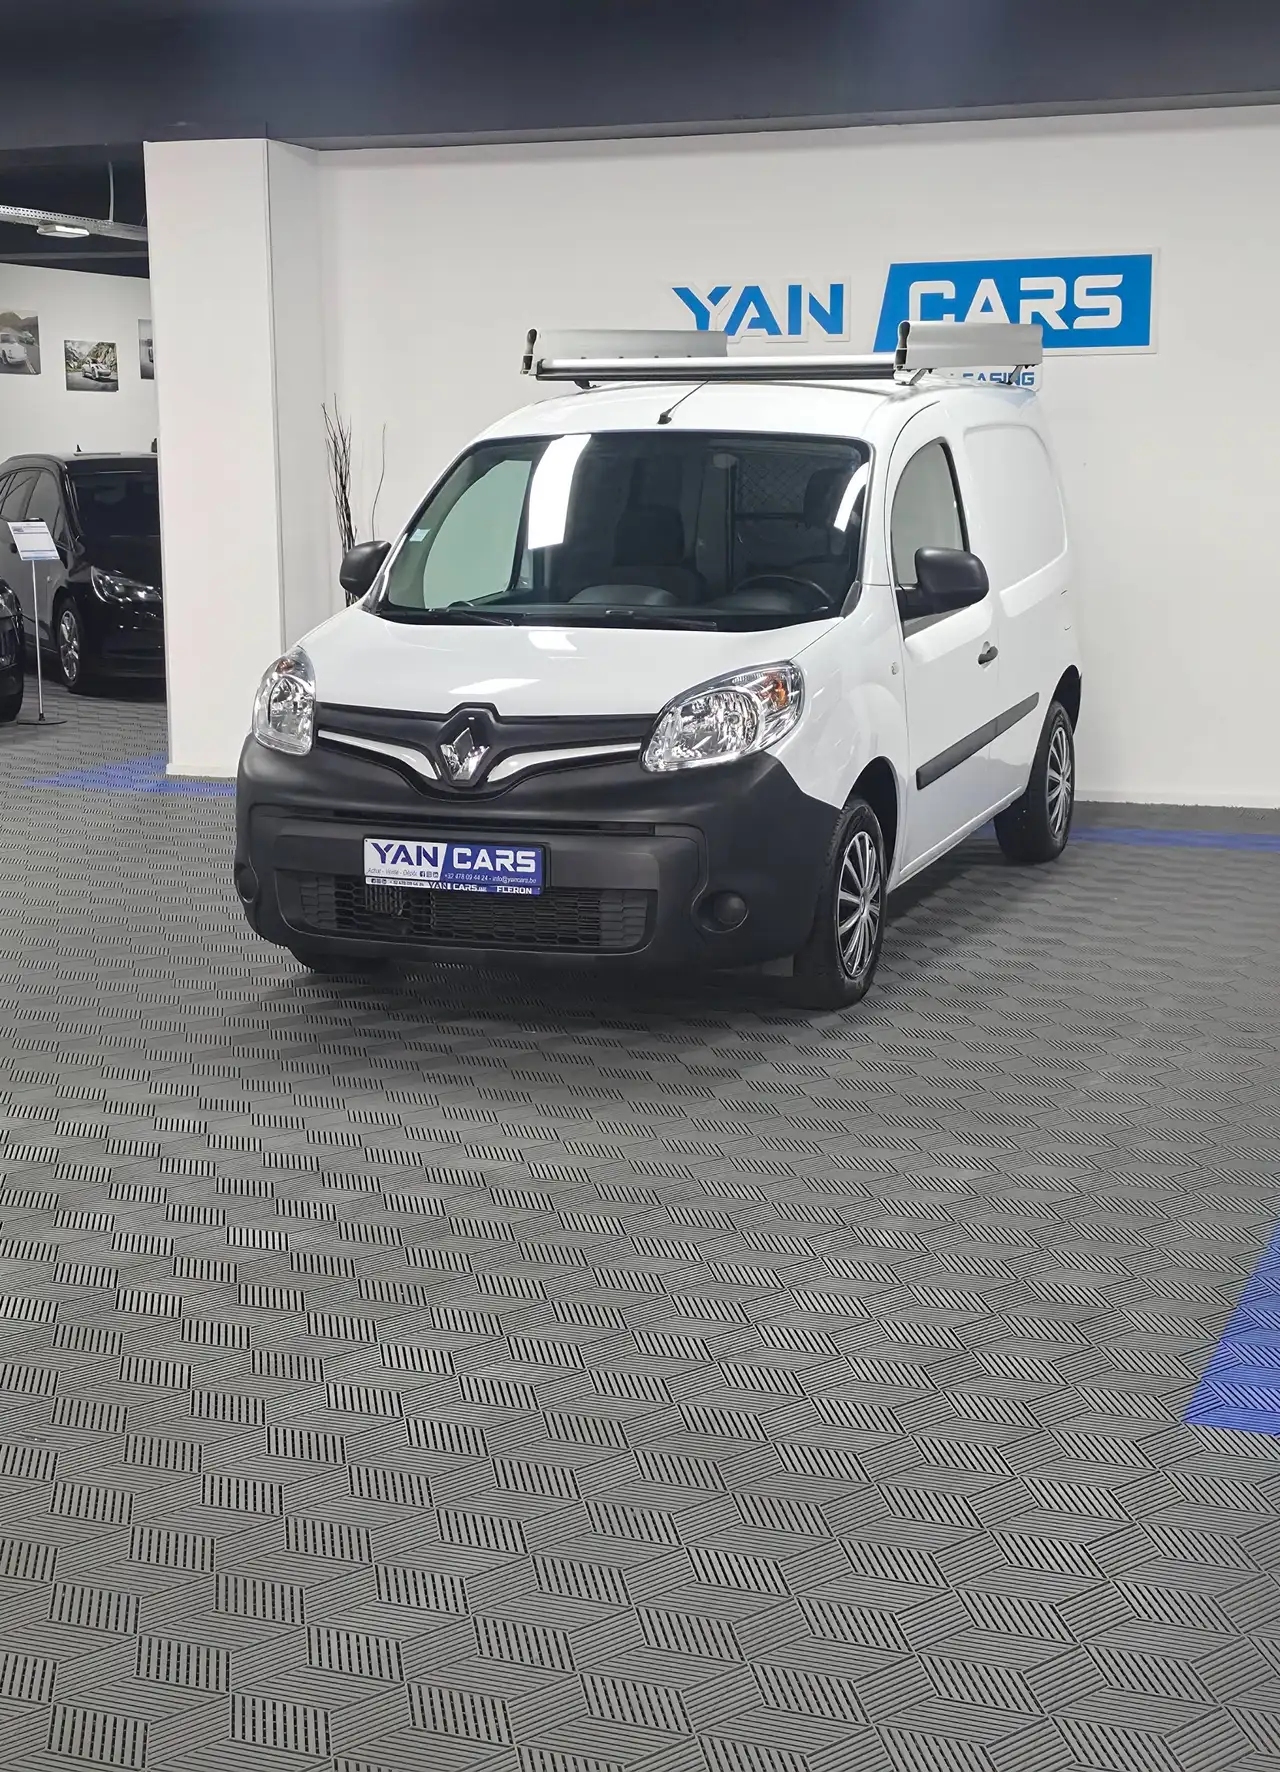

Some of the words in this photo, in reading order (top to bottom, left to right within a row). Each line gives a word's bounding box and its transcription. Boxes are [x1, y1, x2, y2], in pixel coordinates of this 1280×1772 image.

[671, 283, 844, 337] YAN
[908, 273, 1124, 330] CARS
[371, 842, 438, 868] YAN
[453, 847, 536, 873] CARS
[496, 885, 532, 895] FLERON
